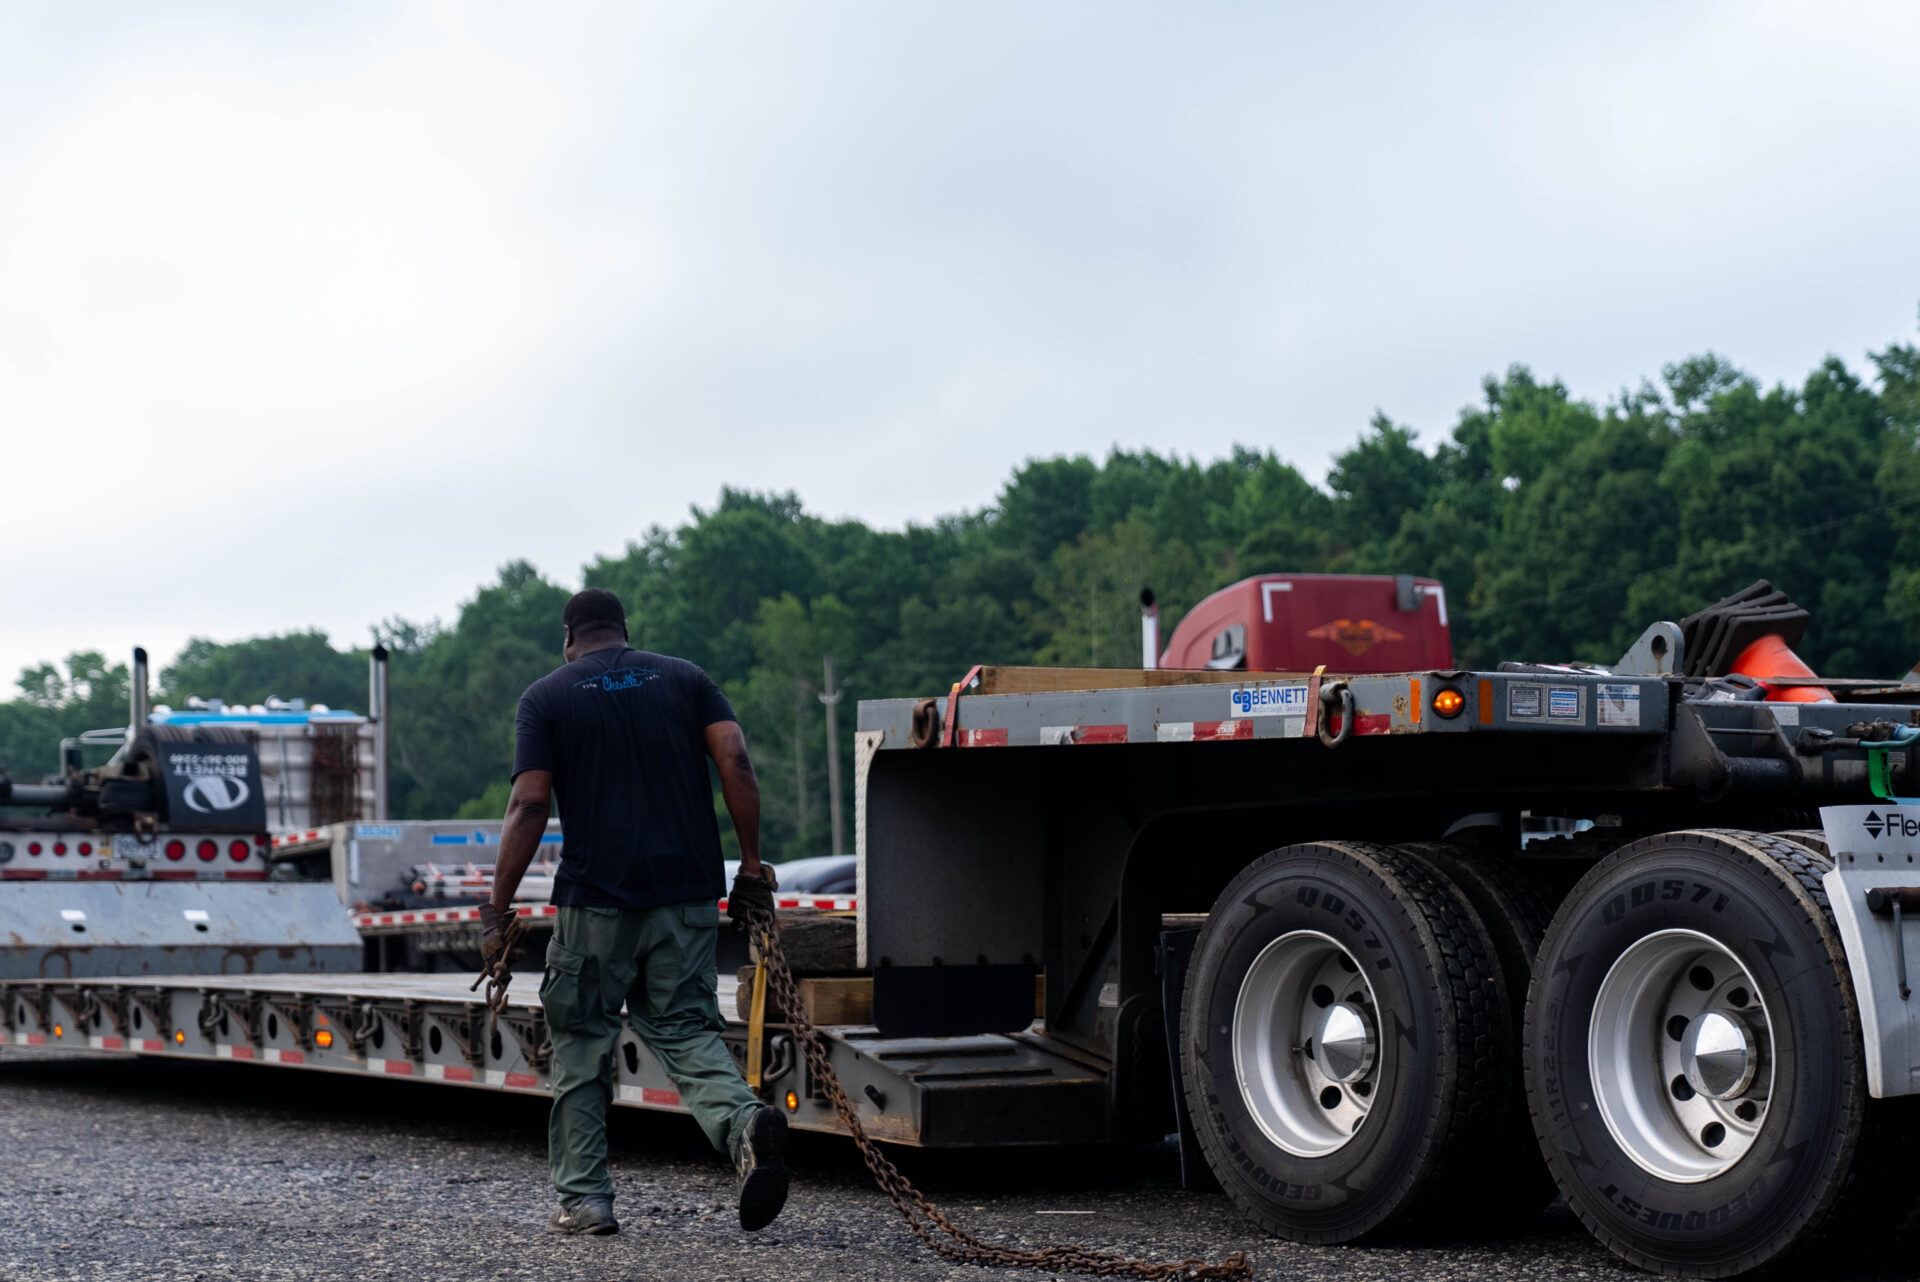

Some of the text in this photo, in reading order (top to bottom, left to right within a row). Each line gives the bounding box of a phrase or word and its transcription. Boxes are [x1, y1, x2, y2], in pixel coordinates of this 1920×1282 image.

[1252, 688, 1307, 704] BENNETT
[173, 763, 247, 777] BENNETT
[1886, 813, 1920, 837] Fle
